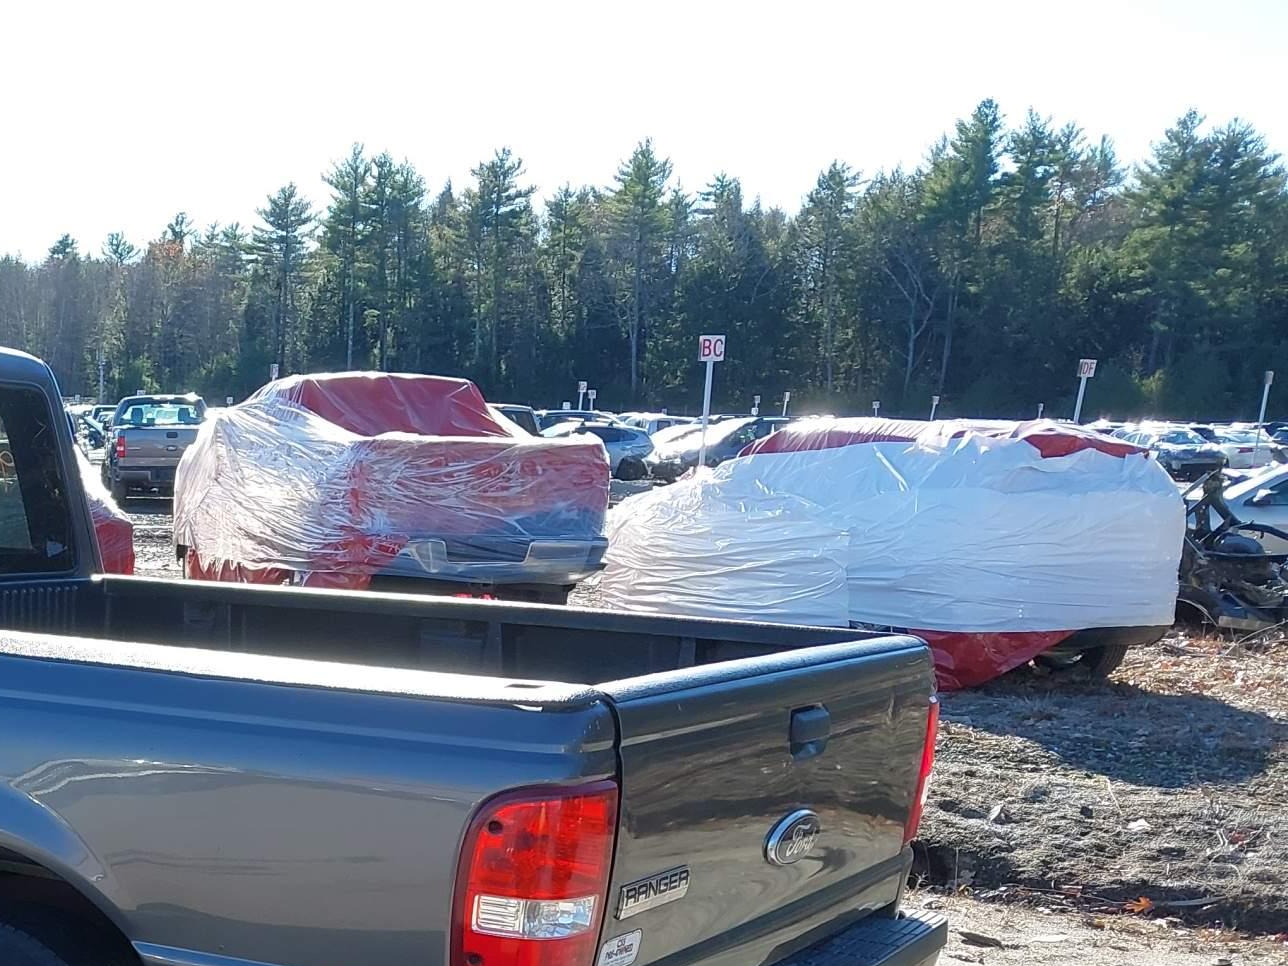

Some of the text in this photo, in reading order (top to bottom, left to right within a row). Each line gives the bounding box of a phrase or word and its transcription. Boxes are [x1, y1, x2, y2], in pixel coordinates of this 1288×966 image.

[702, 338, 724, 358] BC
[786, 824, 819, 857] Ford
[625, 871, 690, 906] RANGER
